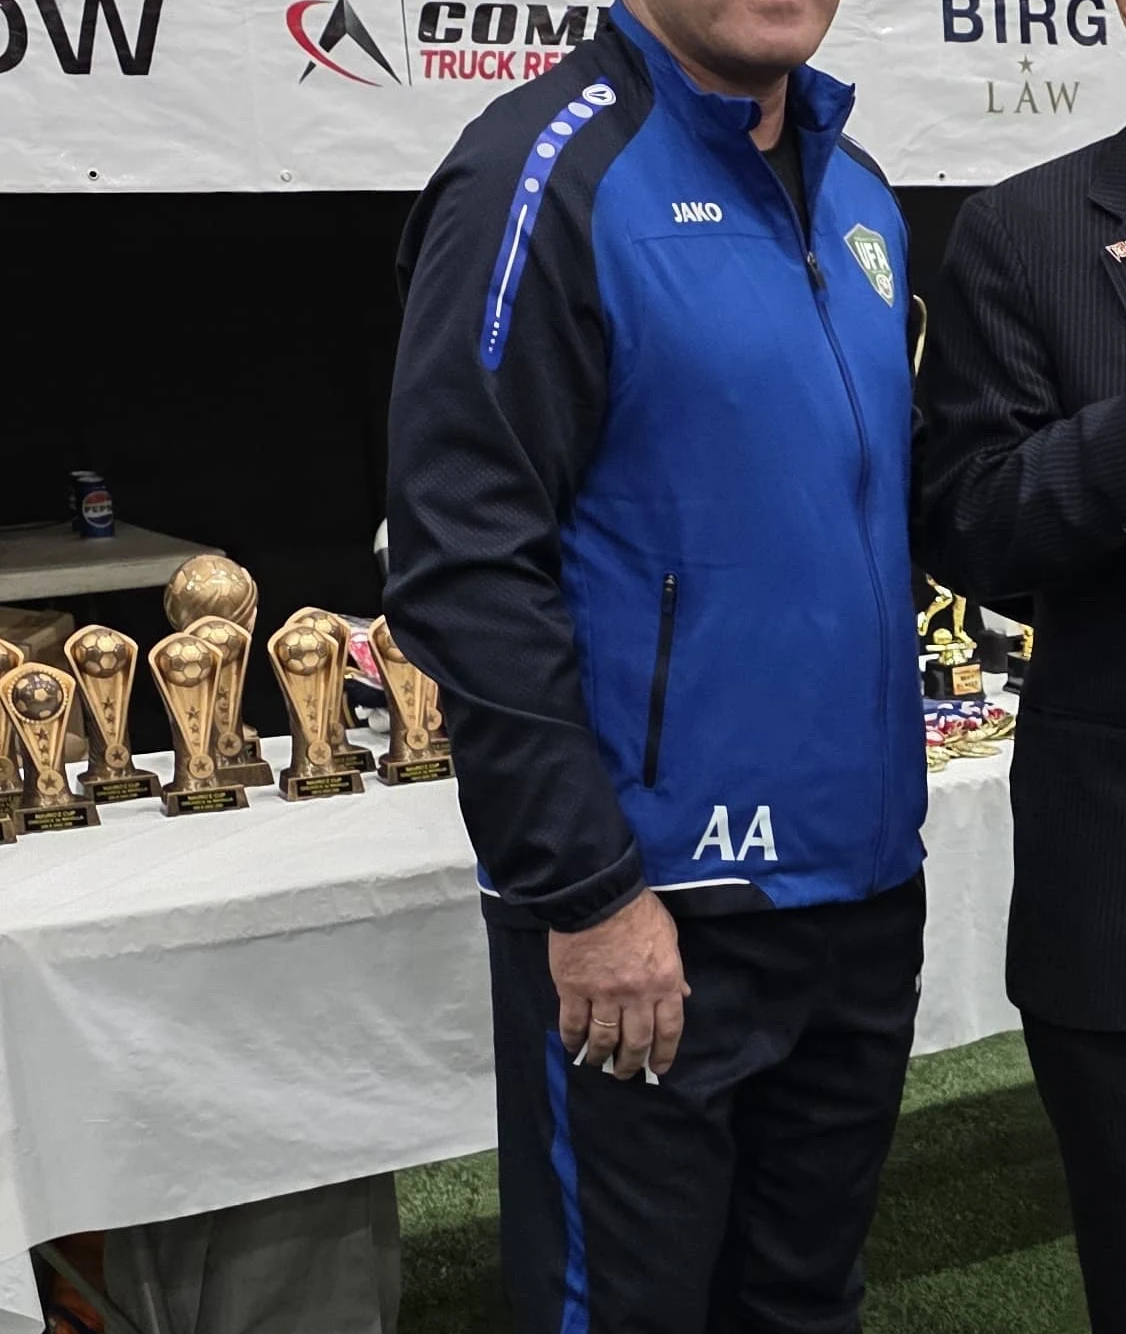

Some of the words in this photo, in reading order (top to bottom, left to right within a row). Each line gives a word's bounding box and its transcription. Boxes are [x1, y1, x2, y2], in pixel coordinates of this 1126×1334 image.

[418, 1, 610, 46] COM
[420, 50, 516, 80] TRUCK
[523, 51, 570, 80] RE
[986, 80, 1081, 115] LAW
[671, 201, 723, 224] JAKO
[854, 240, 892, 271] UFA
[692, 805, 779, 861] AA
